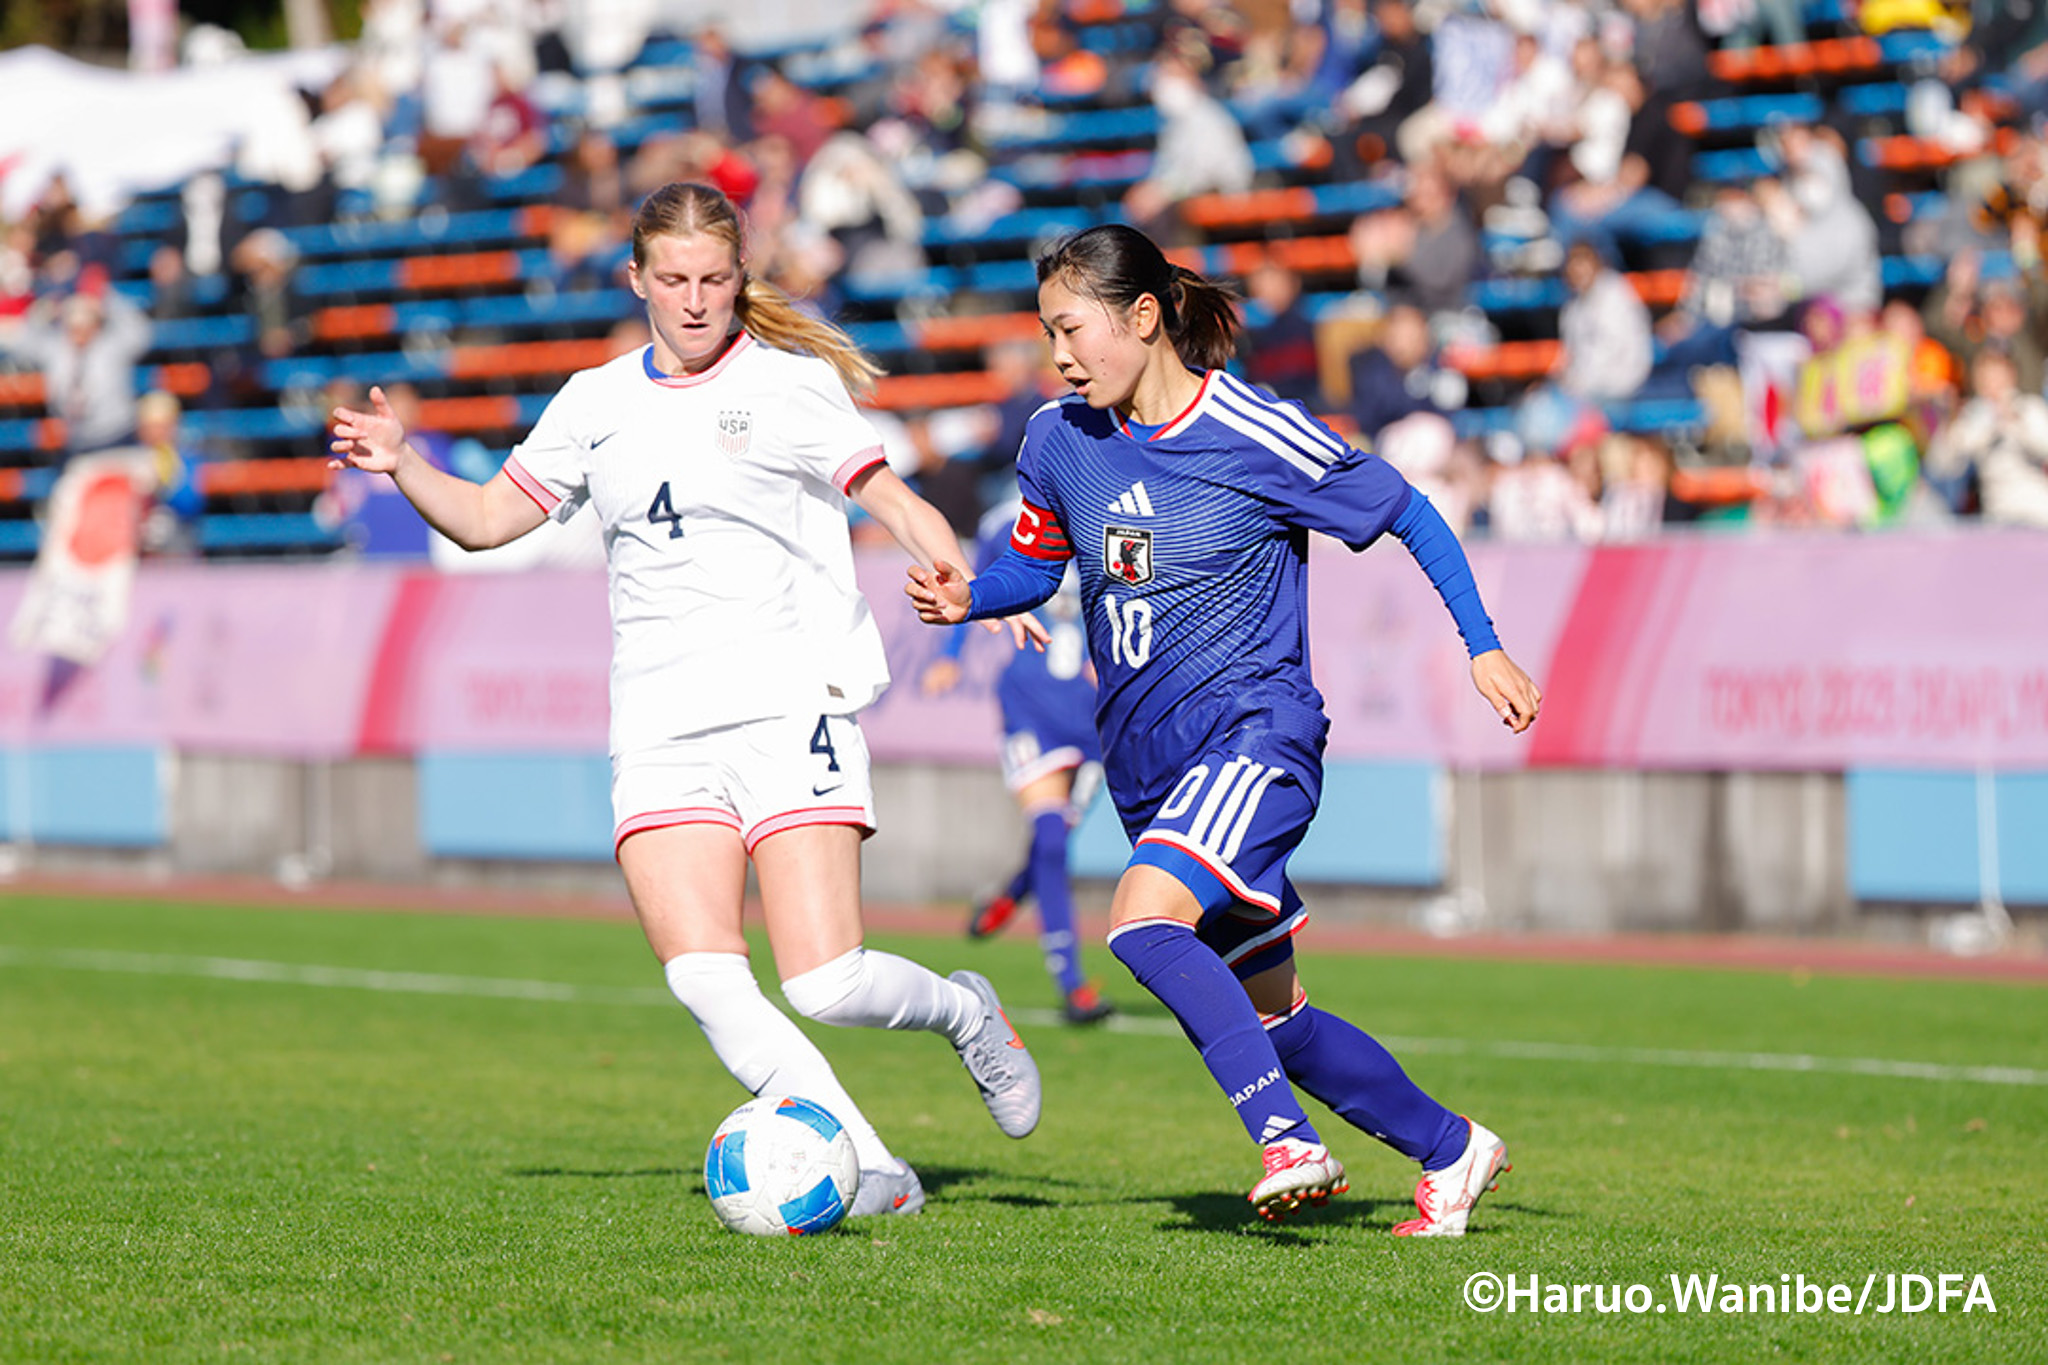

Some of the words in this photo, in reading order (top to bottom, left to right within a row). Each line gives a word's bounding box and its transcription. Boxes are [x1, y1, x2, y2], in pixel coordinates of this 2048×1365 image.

[719, 419, 748, 435] USA
[648, 481, 684, 539] 4
[1012, 504, 1040, 545] C
[1105, 594, 1153, 670] 10
[809, 714, 840, 772] 4
[1229, 1067, 1281, 1107] JAPAN
